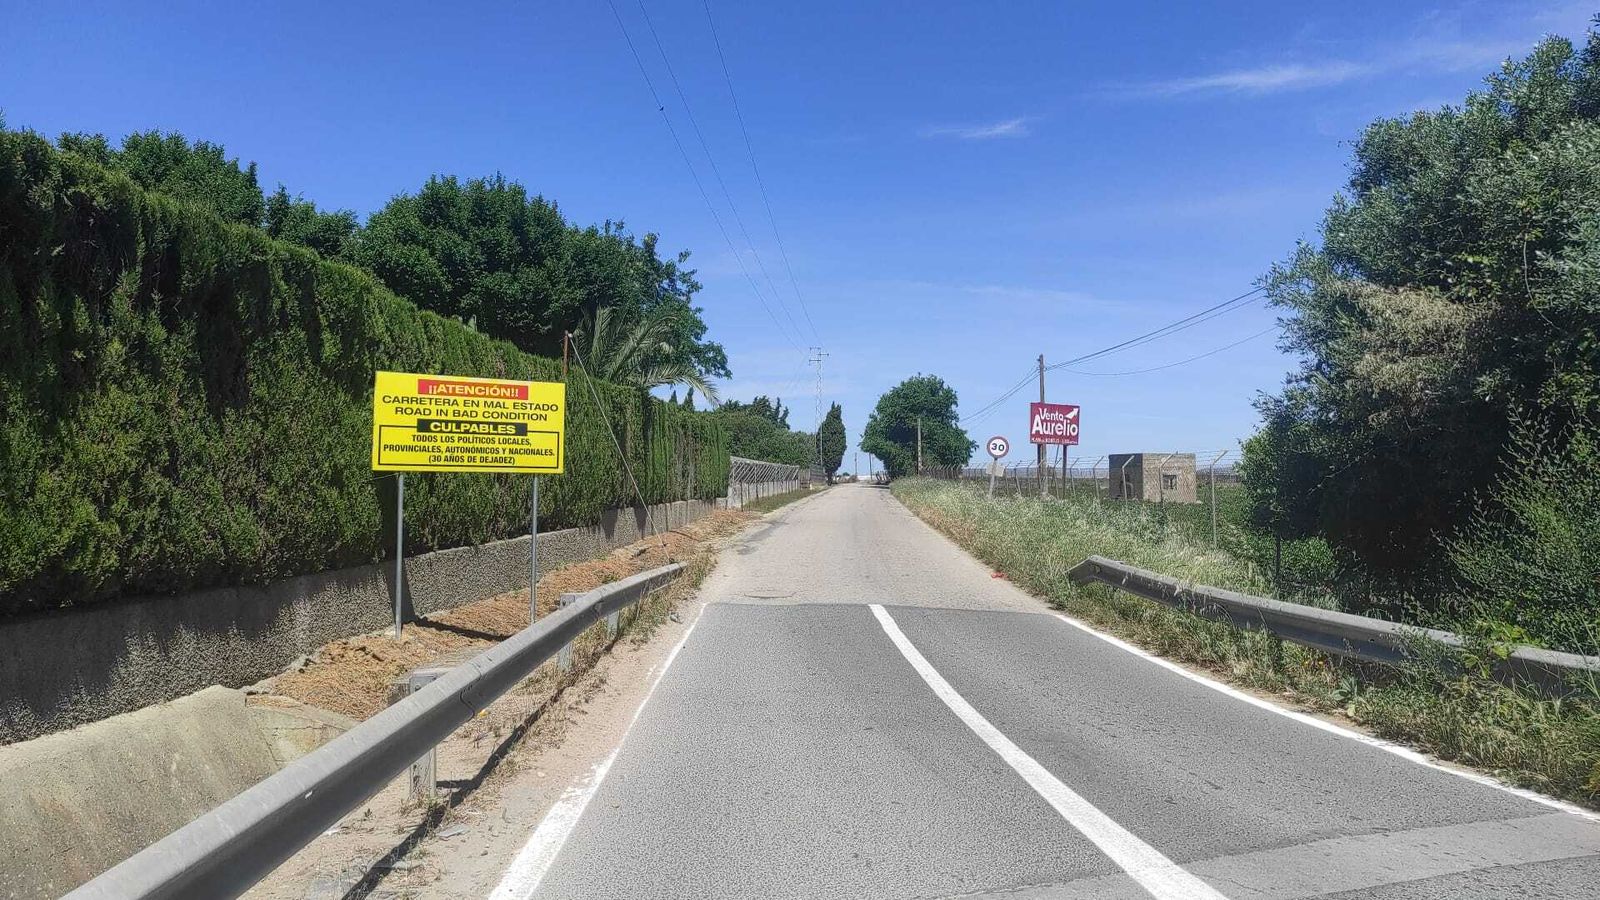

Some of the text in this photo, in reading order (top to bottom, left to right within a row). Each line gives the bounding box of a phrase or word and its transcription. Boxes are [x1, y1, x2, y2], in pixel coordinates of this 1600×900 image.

[429, 384, 519, 397] ¡¡ATENCIÓN!!
[382, 395, 558, 412] CARRETERA EN MAL ESTADO
[395, 407, 547, 420] ROAD IN BAD CONDITION
[1039, 407, 1064, 421] Venta
[430, 422, 516, 434] CULPABLES
[1032, 414, 1078, 436] Aurelio
[412, 435, 437, 443] TODOS
[457, 436, 495, 444] POLÍTICOS
[498, 438, 532, 446] LOCALES,
[383, 444, 443, 454] PROVINCIALES,
[501, 447, 507, 455] Y
[509, 448, 555, 456] NACIONALES.
[991, 443, 1004, 451] 30
[429, 456, 442, 464] (30
[444, 455, 465, 463] AÑOS
[480, 456, 515, 465] DEJADEZ)
